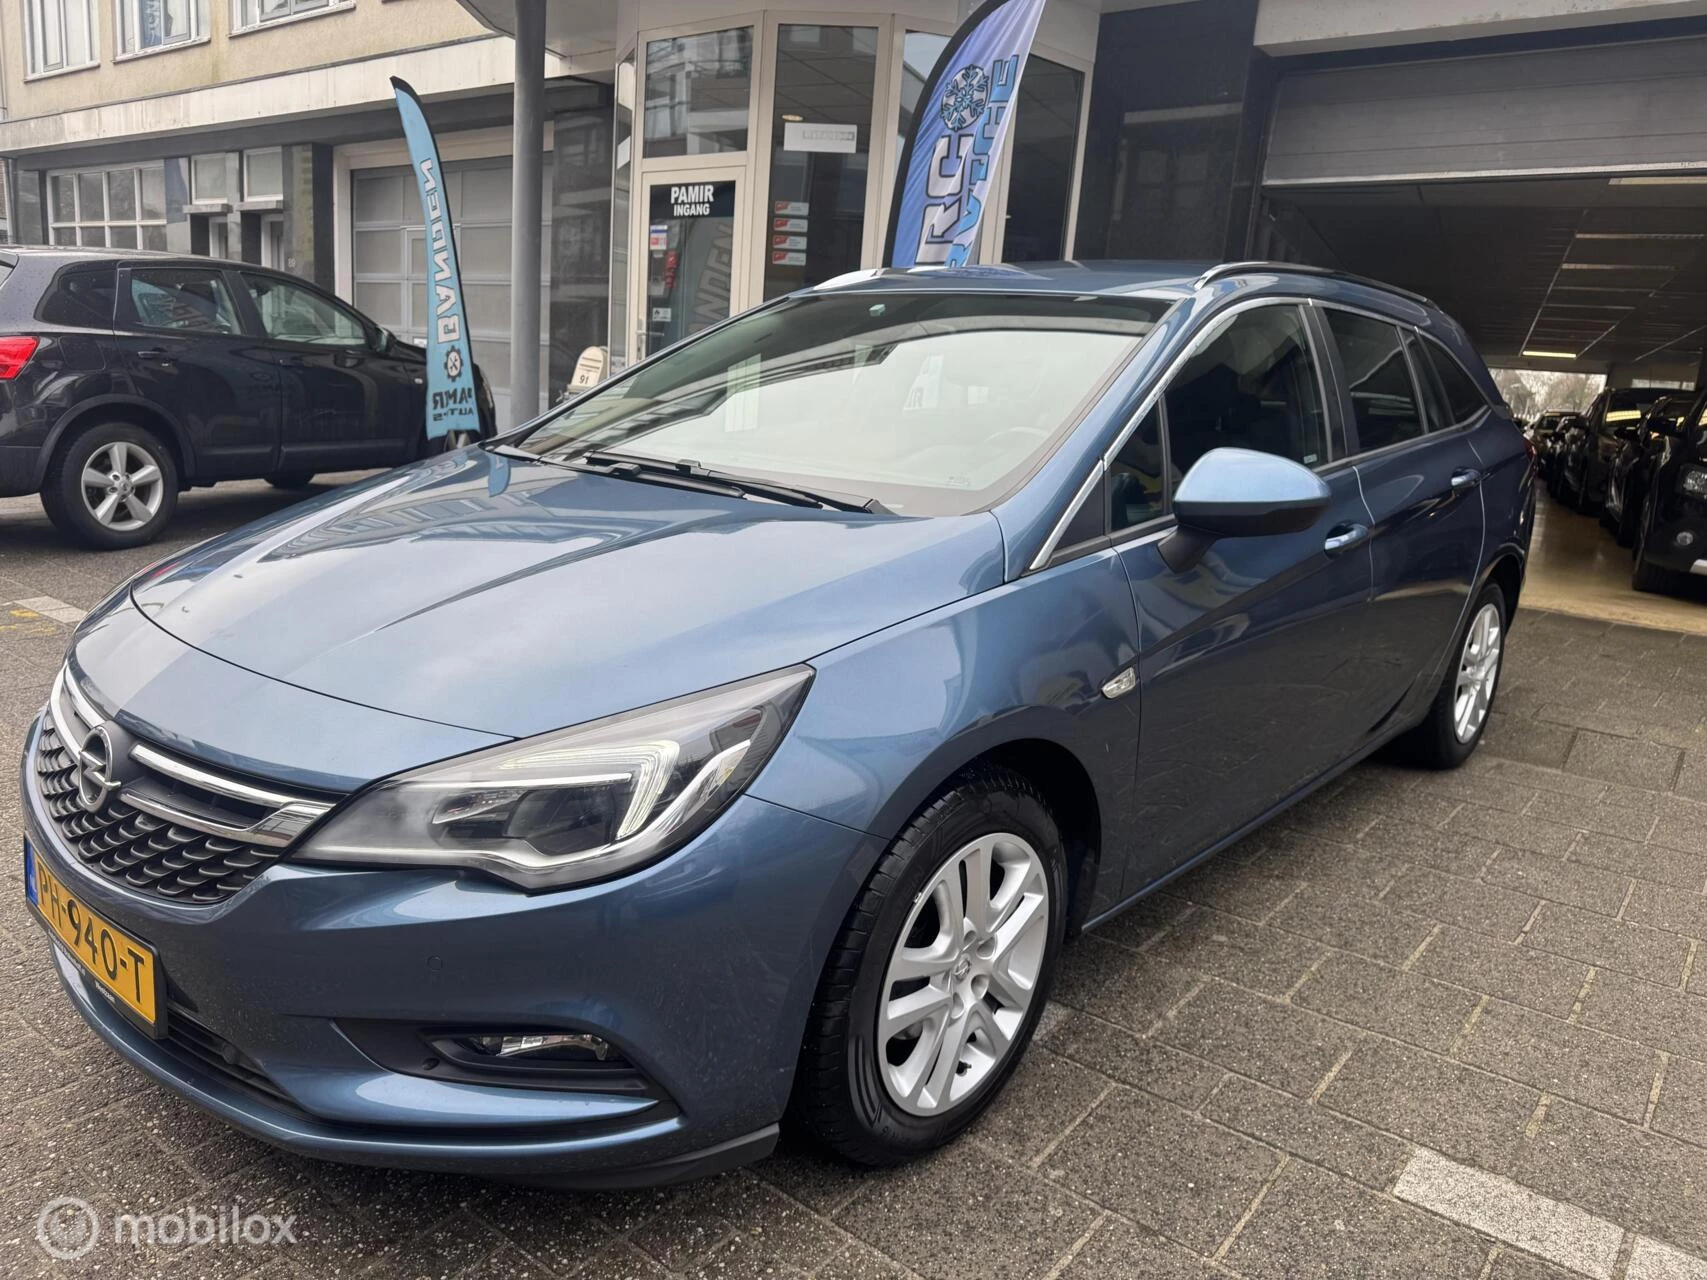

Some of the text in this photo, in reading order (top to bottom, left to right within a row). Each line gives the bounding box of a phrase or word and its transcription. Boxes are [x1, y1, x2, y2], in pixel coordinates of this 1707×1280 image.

[671, 184, 715, 204] PAMIR
[673, 203, 711, 217] INGANG
[36, 861, 145, 1004] PH-940-T
